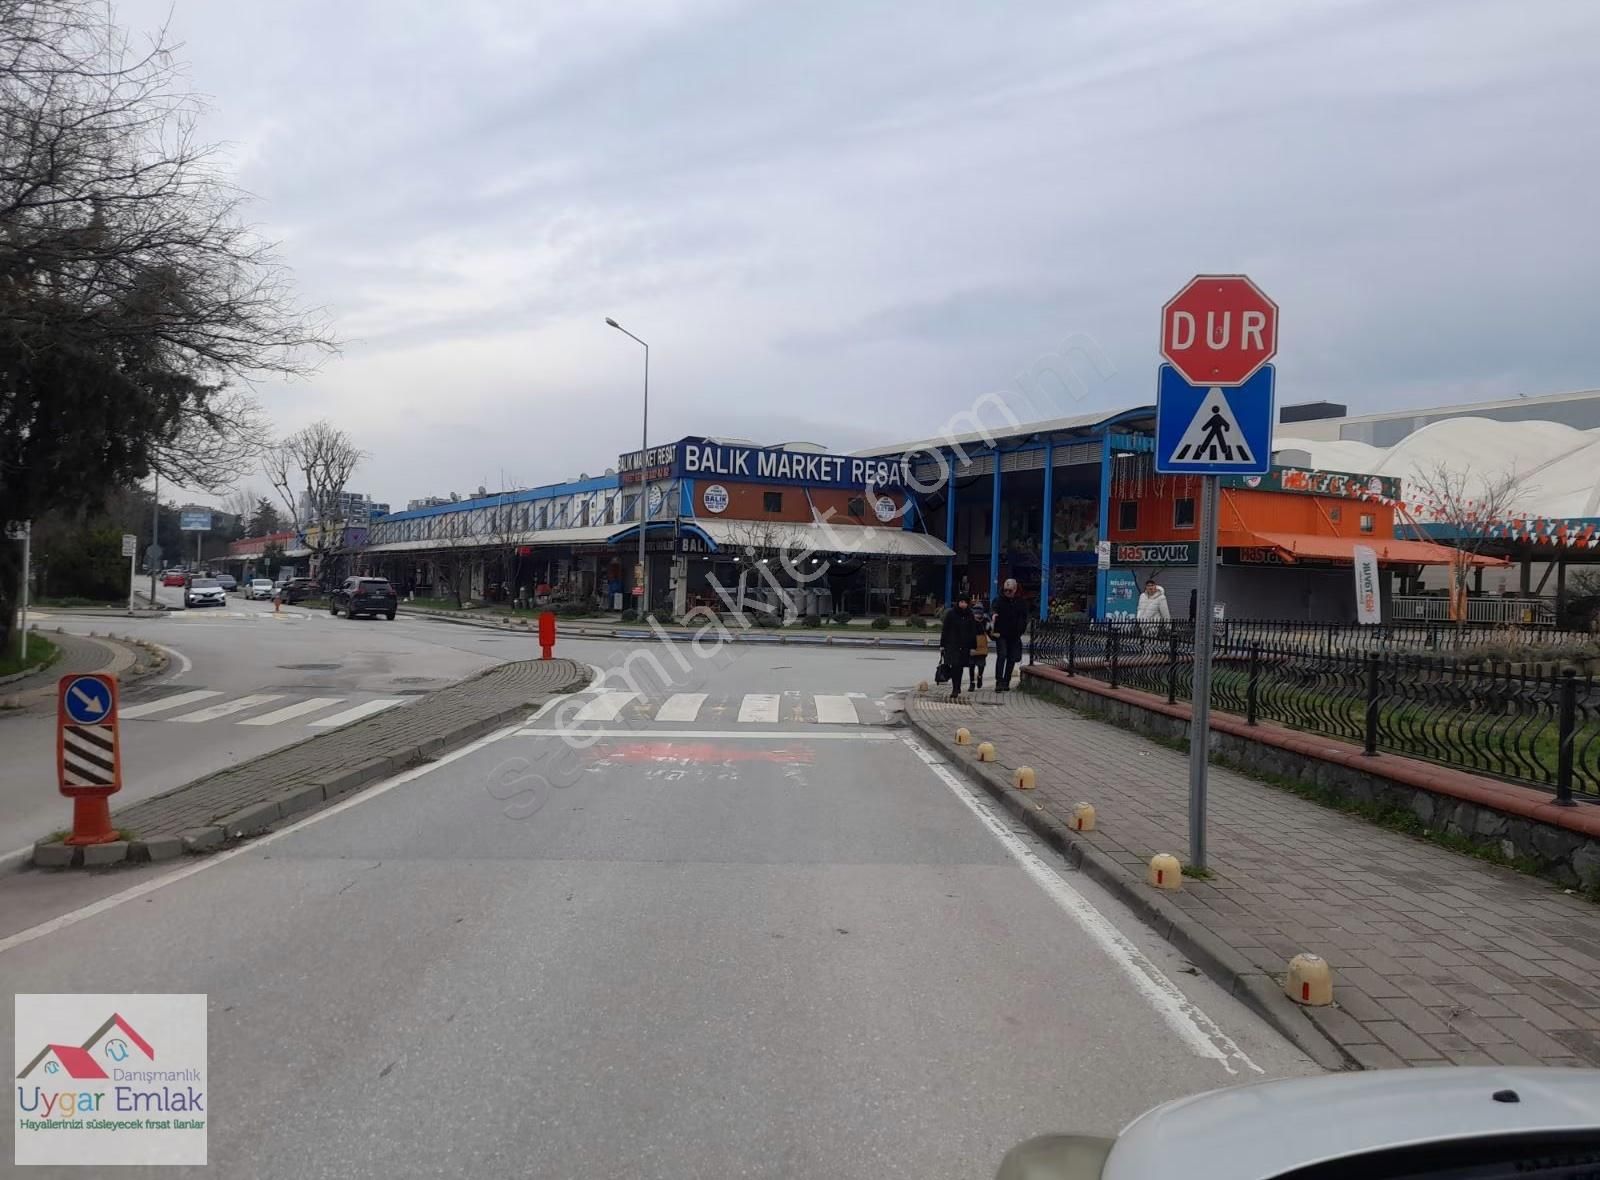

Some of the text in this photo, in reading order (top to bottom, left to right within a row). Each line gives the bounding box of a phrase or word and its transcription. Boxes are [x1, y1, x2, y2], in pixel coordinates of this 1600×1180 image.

[1171, 311, 1266, 350] DUR
[633, 449, 657, 470] MAKET
[685, 445, 750, 475] BALIK
[757, 451, 846, 482] MARKET
